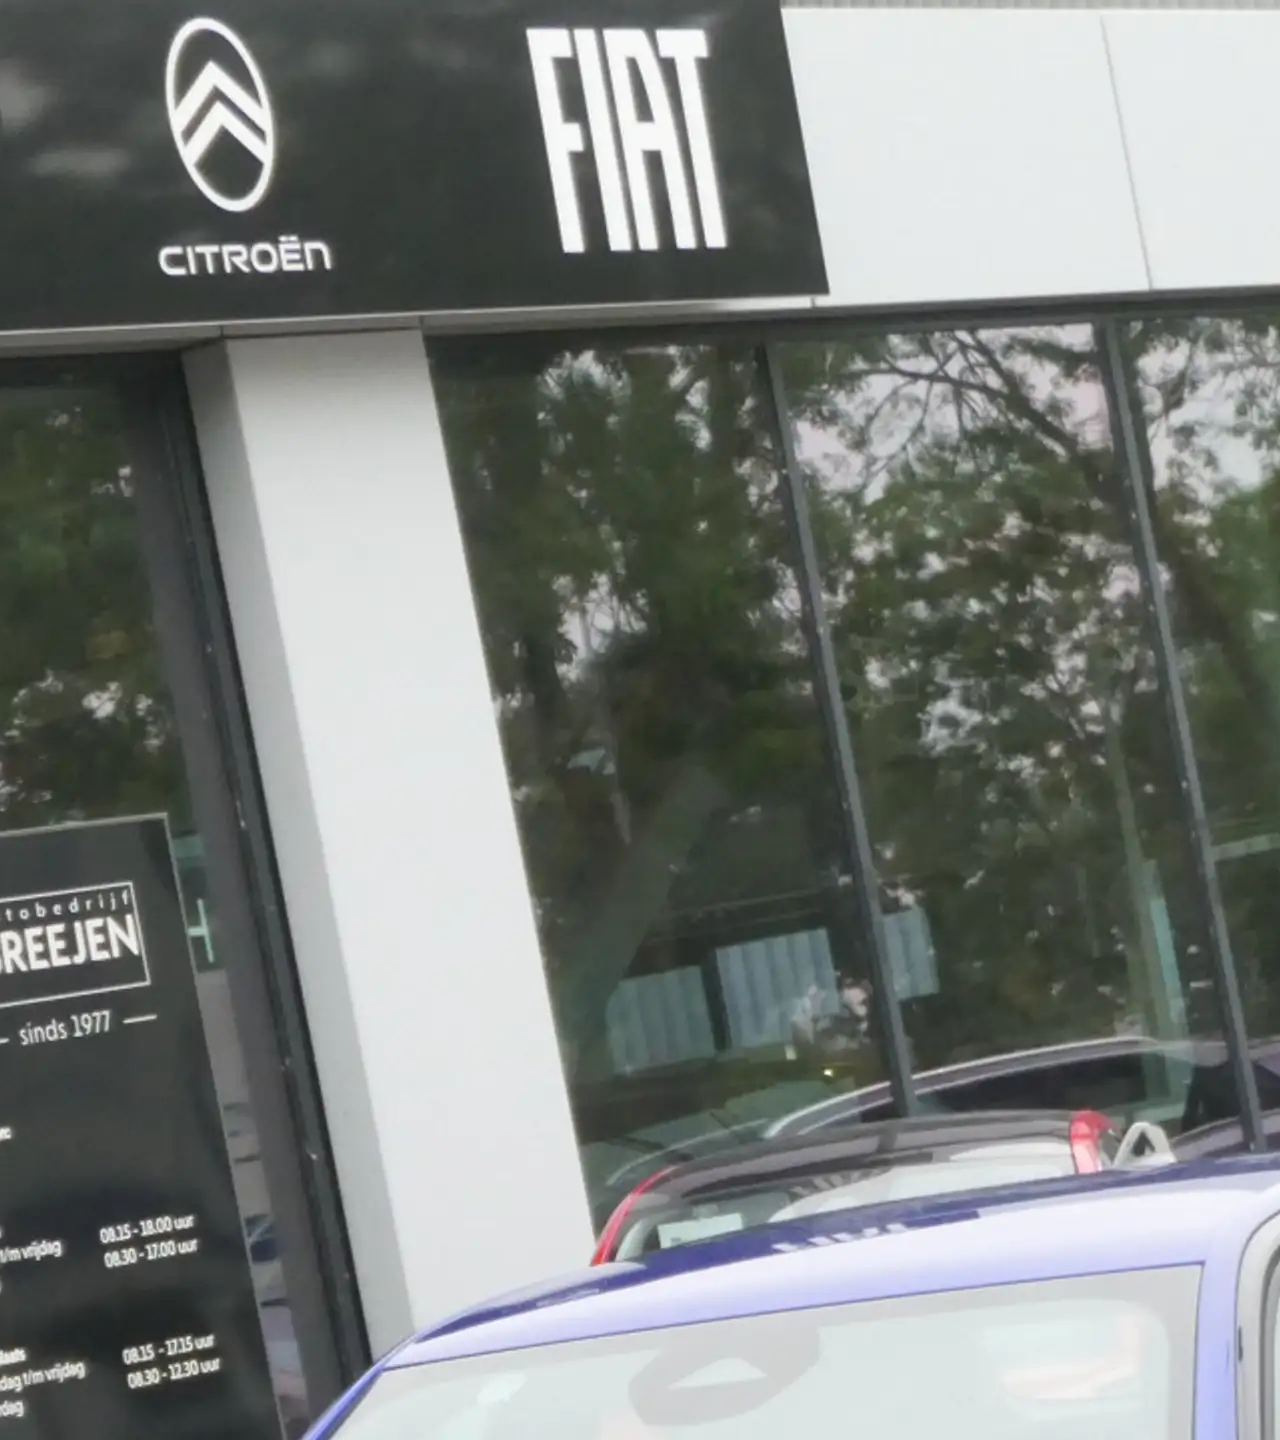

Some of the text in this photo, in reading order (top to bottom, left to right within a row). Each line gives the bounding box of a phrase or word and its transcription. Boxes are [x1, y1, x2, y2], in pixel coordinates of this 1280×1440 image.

[525, 28, 728, 253] FIAT
[158, 236, 332, 277] CITROËN
[19, 1010, 111, 1046] sinds 1977
[173, 1215, 194, 1230] uur
[21, 1240, 63, 1261] vrijdag
[177, 1239, 198, 1254] uur
[194, 1334, 215, 1349] uur
[45, 1361, 86, 1383] vrijdag
[200, 1357, 220, 1372] uur
